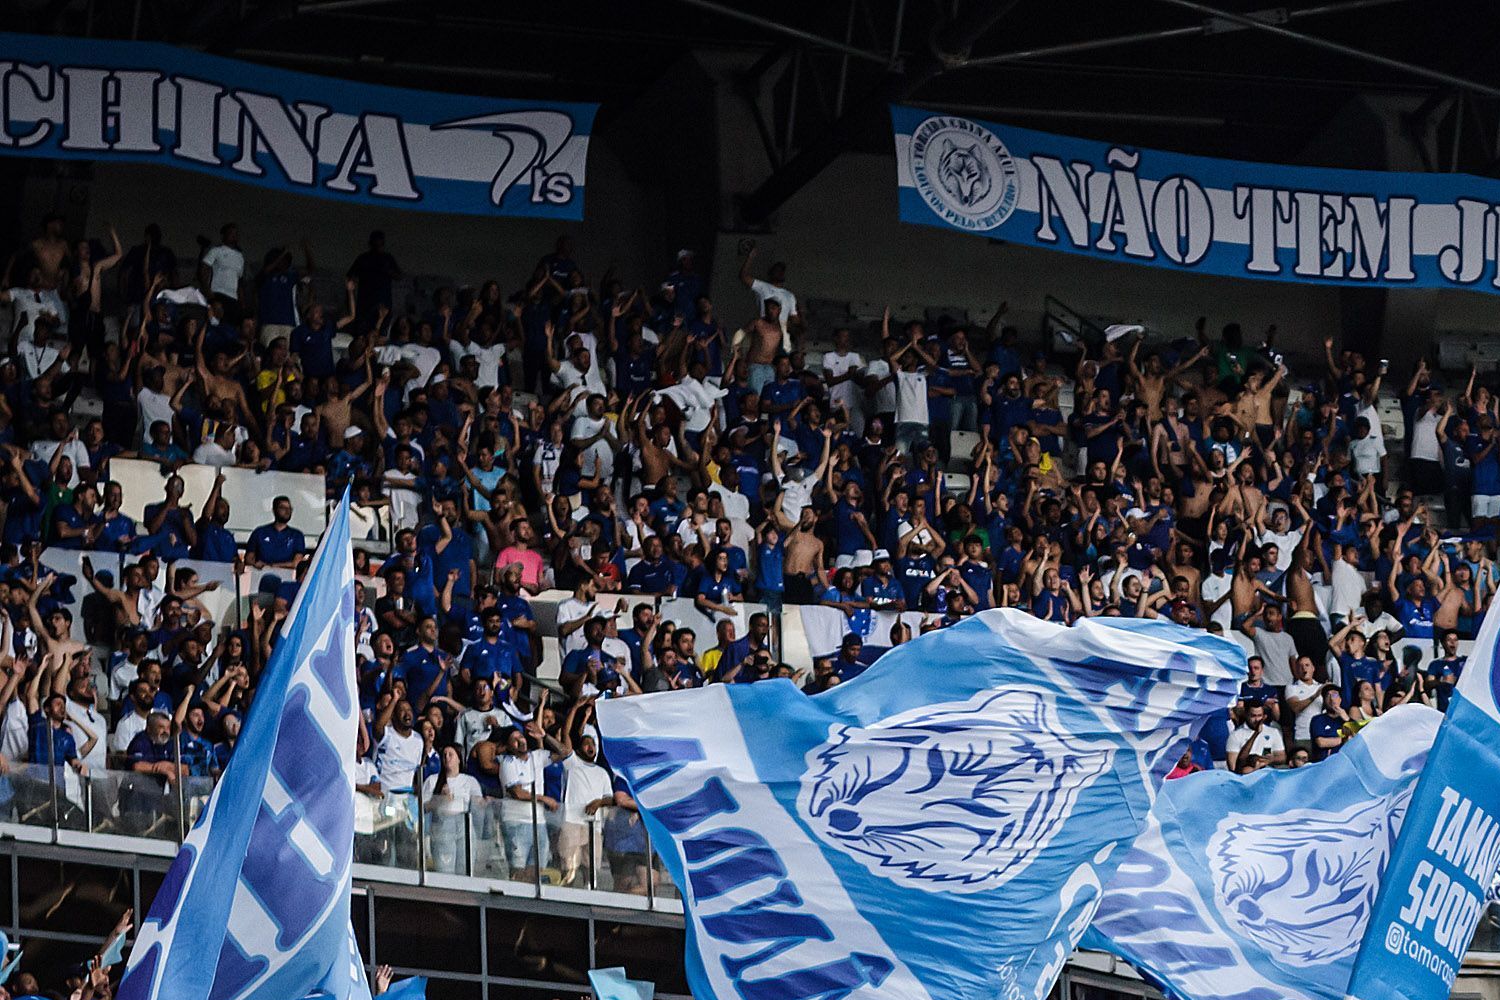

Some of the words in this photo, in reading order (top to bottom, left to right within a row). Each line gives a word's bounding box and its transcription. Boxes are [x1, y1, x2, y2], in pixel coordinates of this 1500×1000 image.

[0, 62, 420, 200] CHINA
[1030, 147, 1214, 266] NÃO
[1234, 186, 1417, 281] TEM
